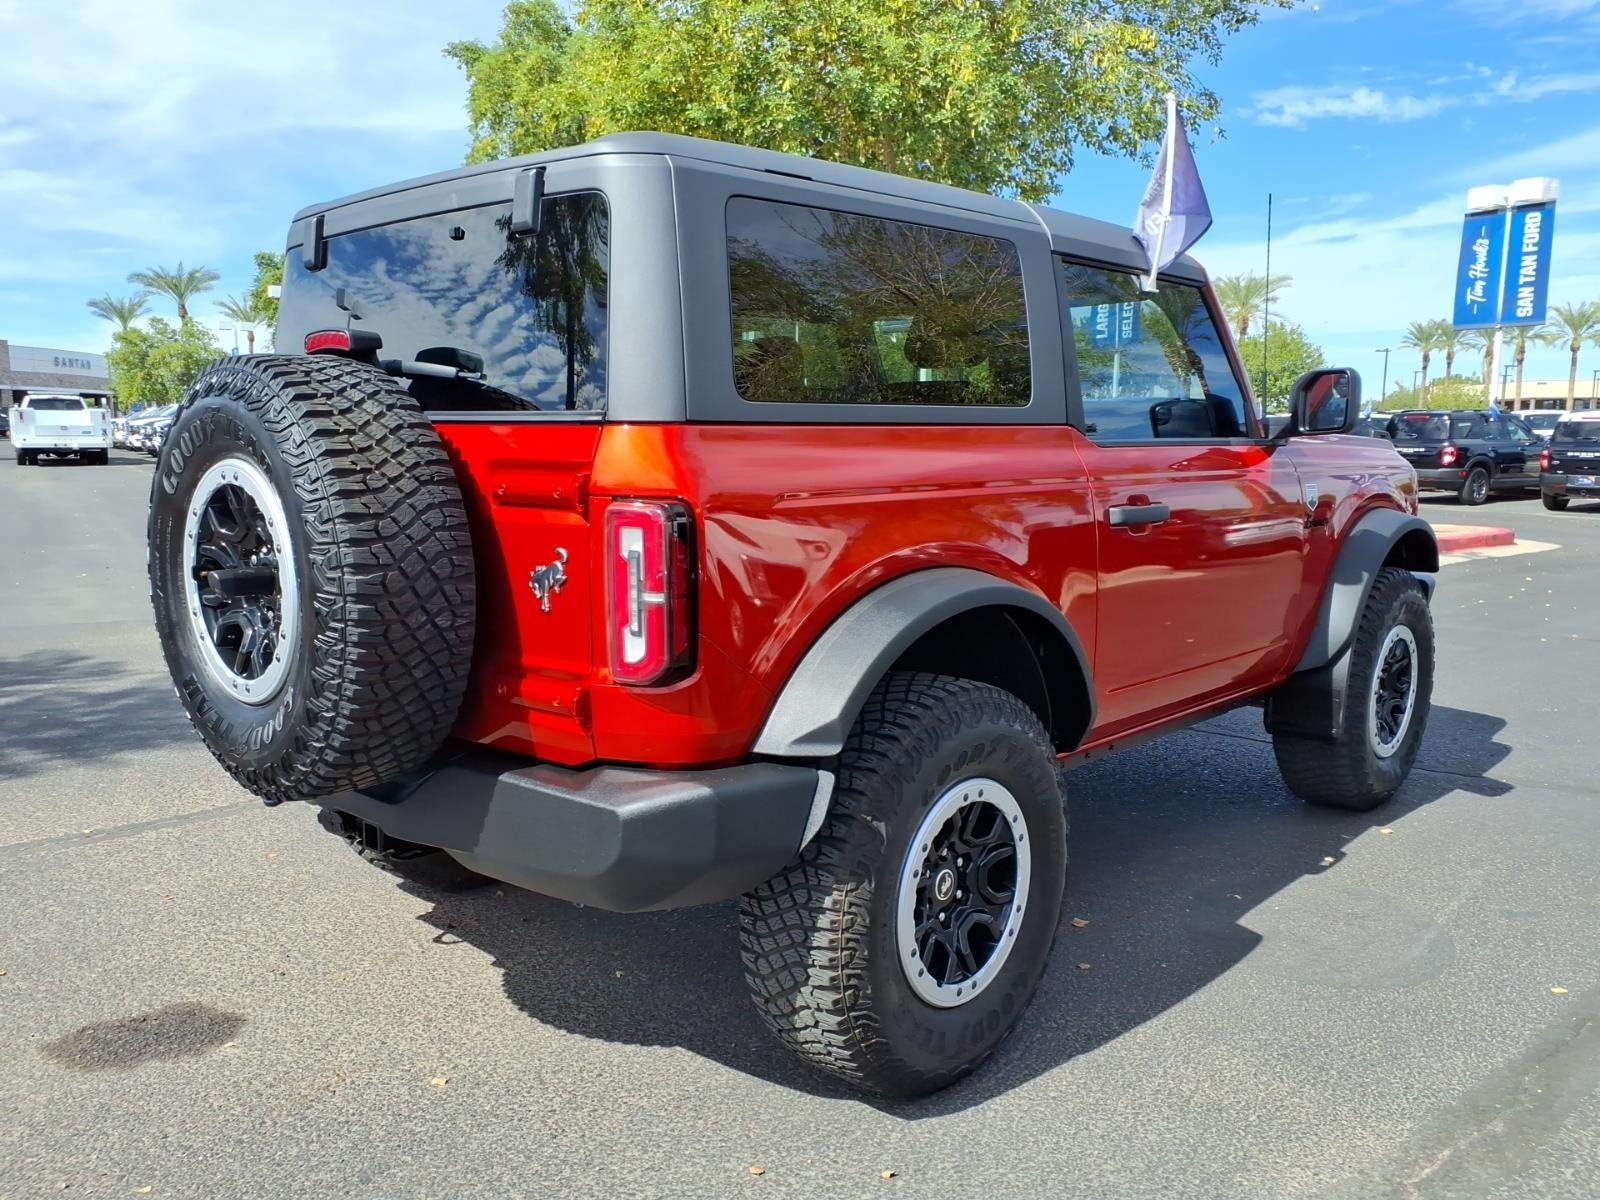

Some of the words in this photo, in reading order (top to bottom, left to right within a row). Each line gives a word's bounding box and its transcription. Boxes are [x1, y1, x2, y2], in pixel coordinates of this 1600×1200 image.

[1521, 211, 1542, 253] FORD
[1518, 254, 1538, 285] TAN
[1466, 279, 1487, 305] Tim
[1516, 286, 1535, 318] SAN
